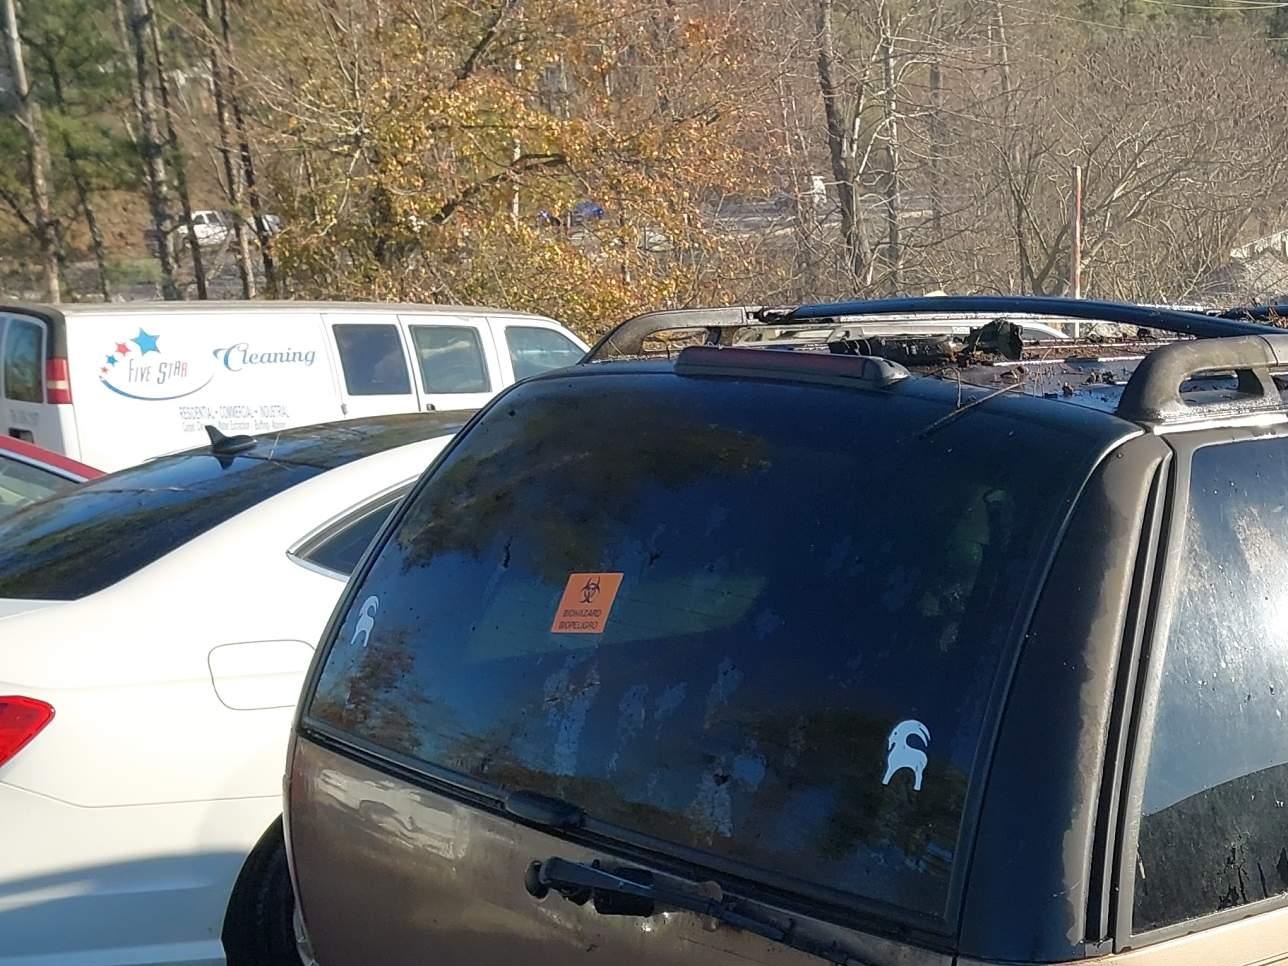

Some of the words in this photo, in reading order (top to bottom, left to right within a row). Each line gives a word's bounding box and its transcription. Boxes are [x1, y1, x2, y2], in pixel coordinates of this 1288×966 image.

[128, 358, 152, 383] FIVE
[157, 359, 188, 385] STAR
[212, 342, 317, 372] Cleaning
